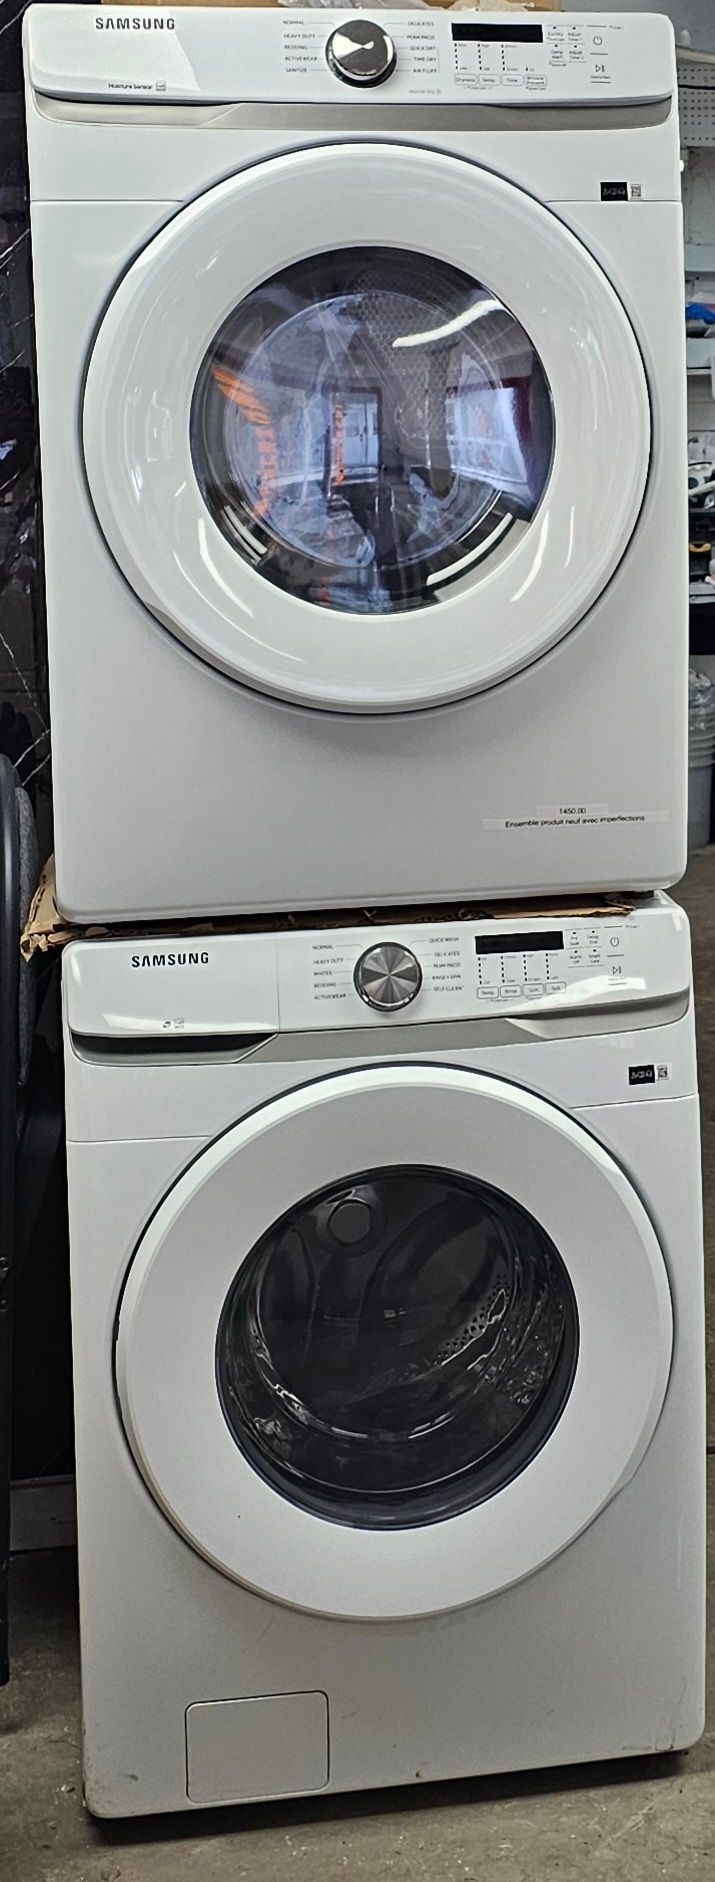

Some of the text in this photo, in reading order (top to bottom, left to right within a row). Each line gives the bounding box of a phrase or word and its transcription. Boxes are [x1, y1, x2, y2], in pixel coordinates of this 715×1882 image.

[95, 17, 175, 30] SAMSUNG
[559, 807, 587, 815] 1450.00
[505, 820, 539, 828] Ensemble
[540, 819, 564, 827] produit
[565, 817, 581, 825] neuf
[600, 815, 645, 823] imperfections
[131, 951, 209, 968] SAMSUNG
